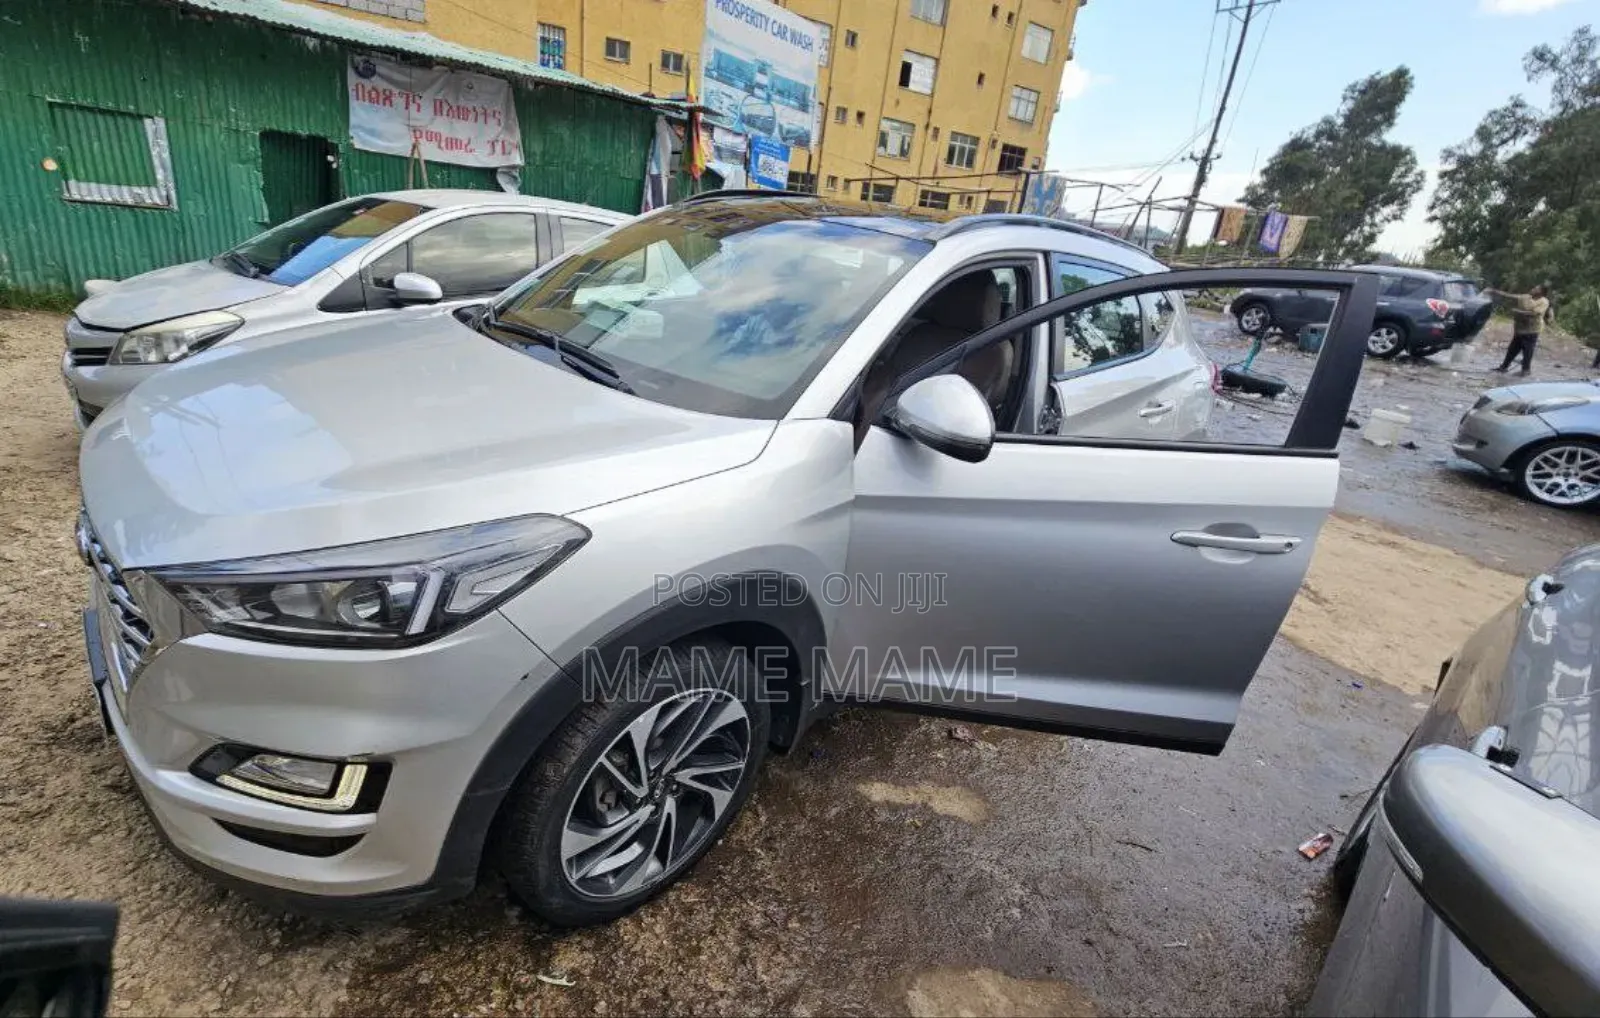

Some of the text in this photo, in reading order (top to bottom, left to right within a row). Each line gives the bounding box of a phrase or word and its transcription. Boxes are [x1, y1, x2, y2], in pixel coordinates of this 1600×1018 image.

[715, 0, 770, 32] PROSPERITY
[771, 20, 788, 41] CAR
[790, 28, 814, 52] WASH
